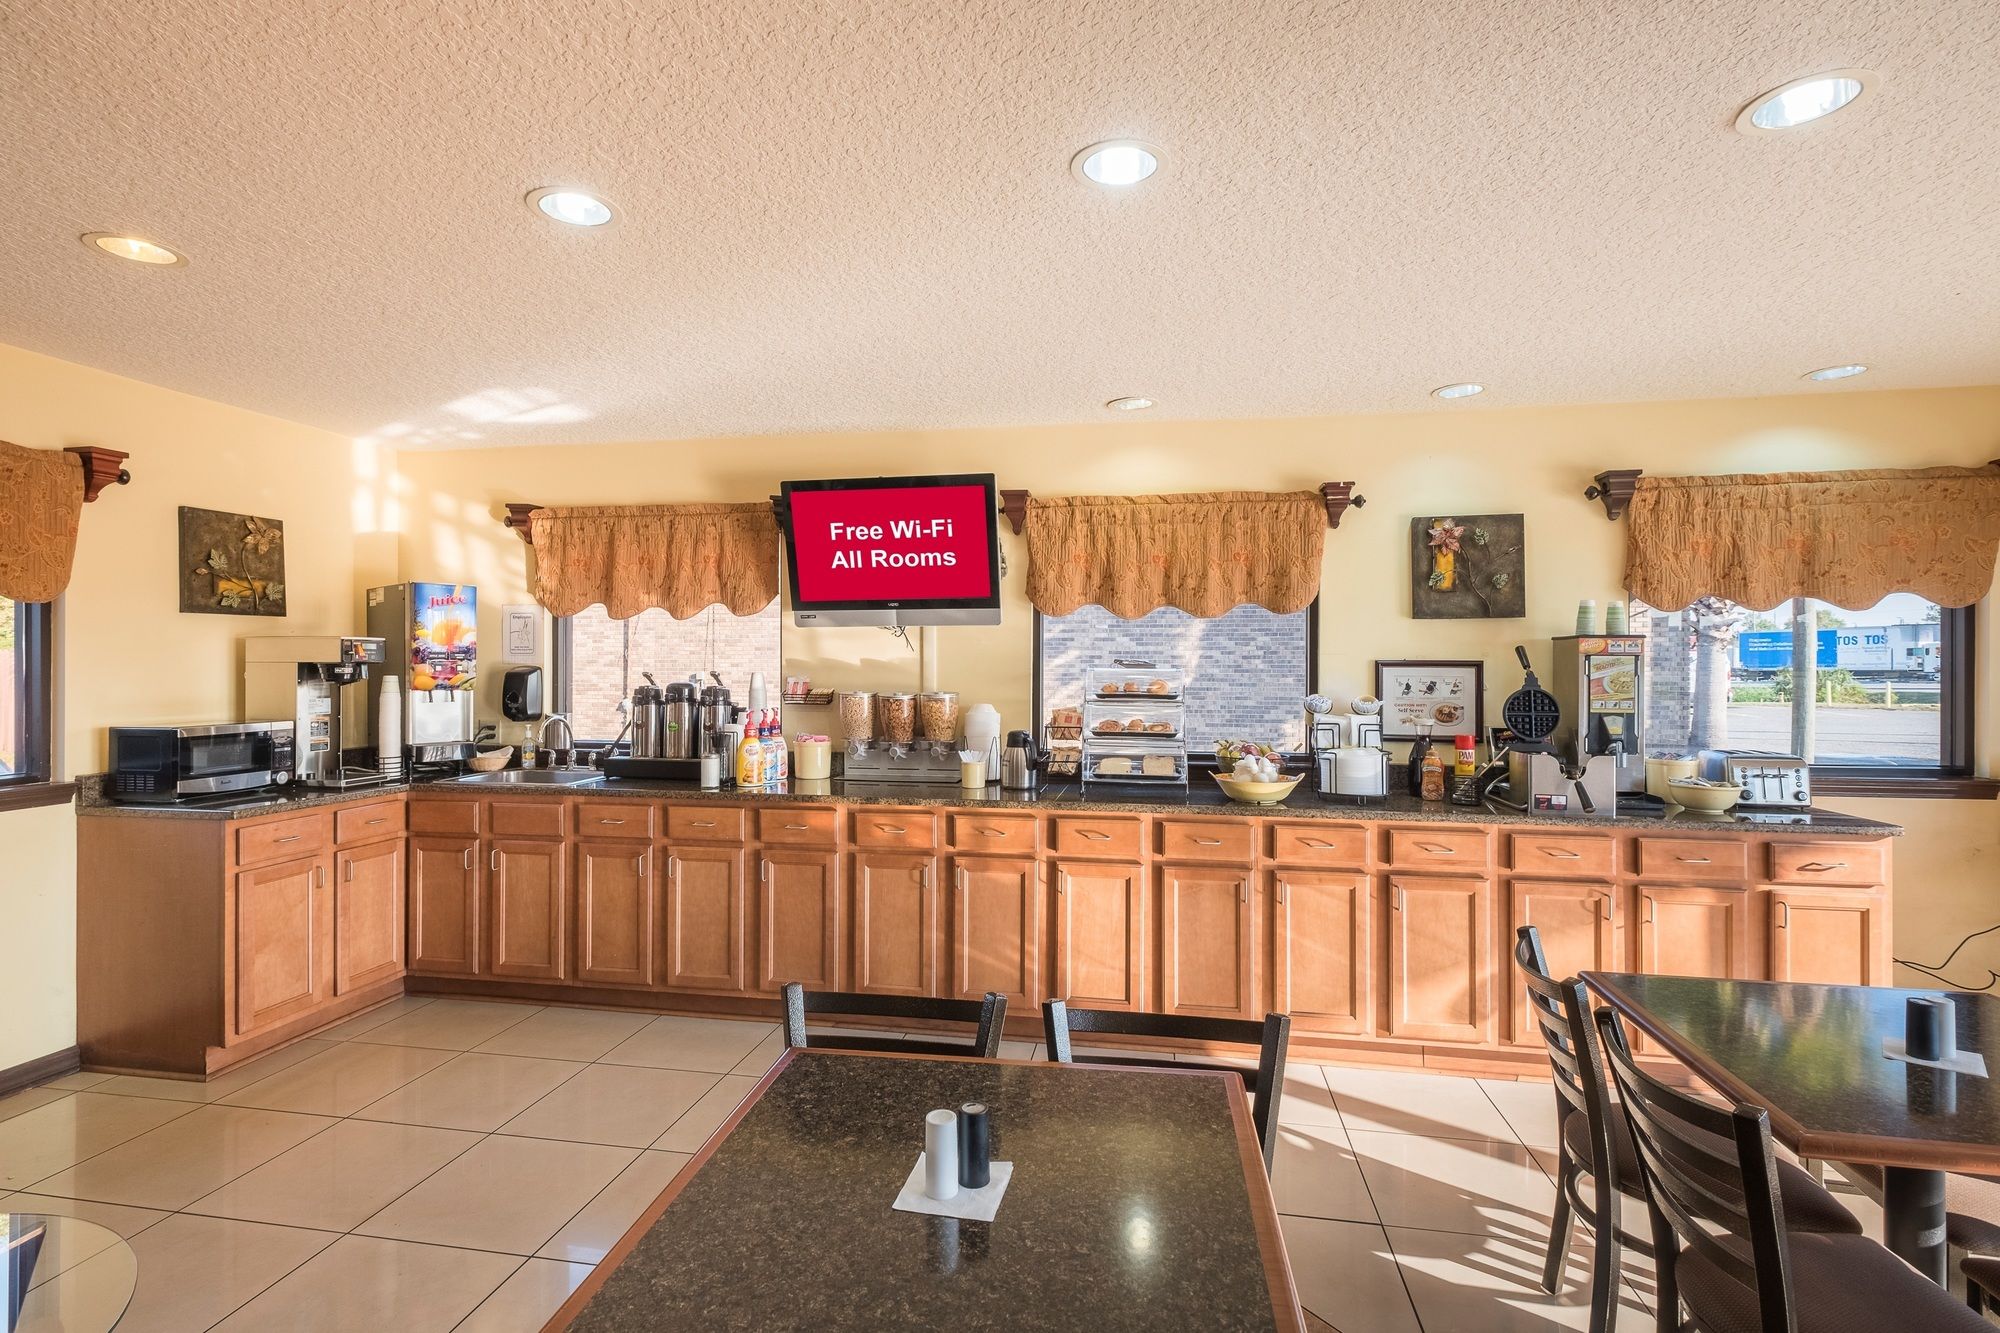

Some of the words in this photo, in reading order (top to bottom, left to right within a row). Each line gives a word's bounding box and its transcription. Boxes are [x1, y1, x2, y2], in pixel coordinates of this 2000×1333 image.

[830, 522, 883, 541] Free
[890, 519, 953, 539] Wi-Fi
[831, 550, 862, 569] All
[871, 549, 956, 568] Rooms
[1864, 634, 1889, 645] TOS
[1458, 751, 1474, 760] PAM
